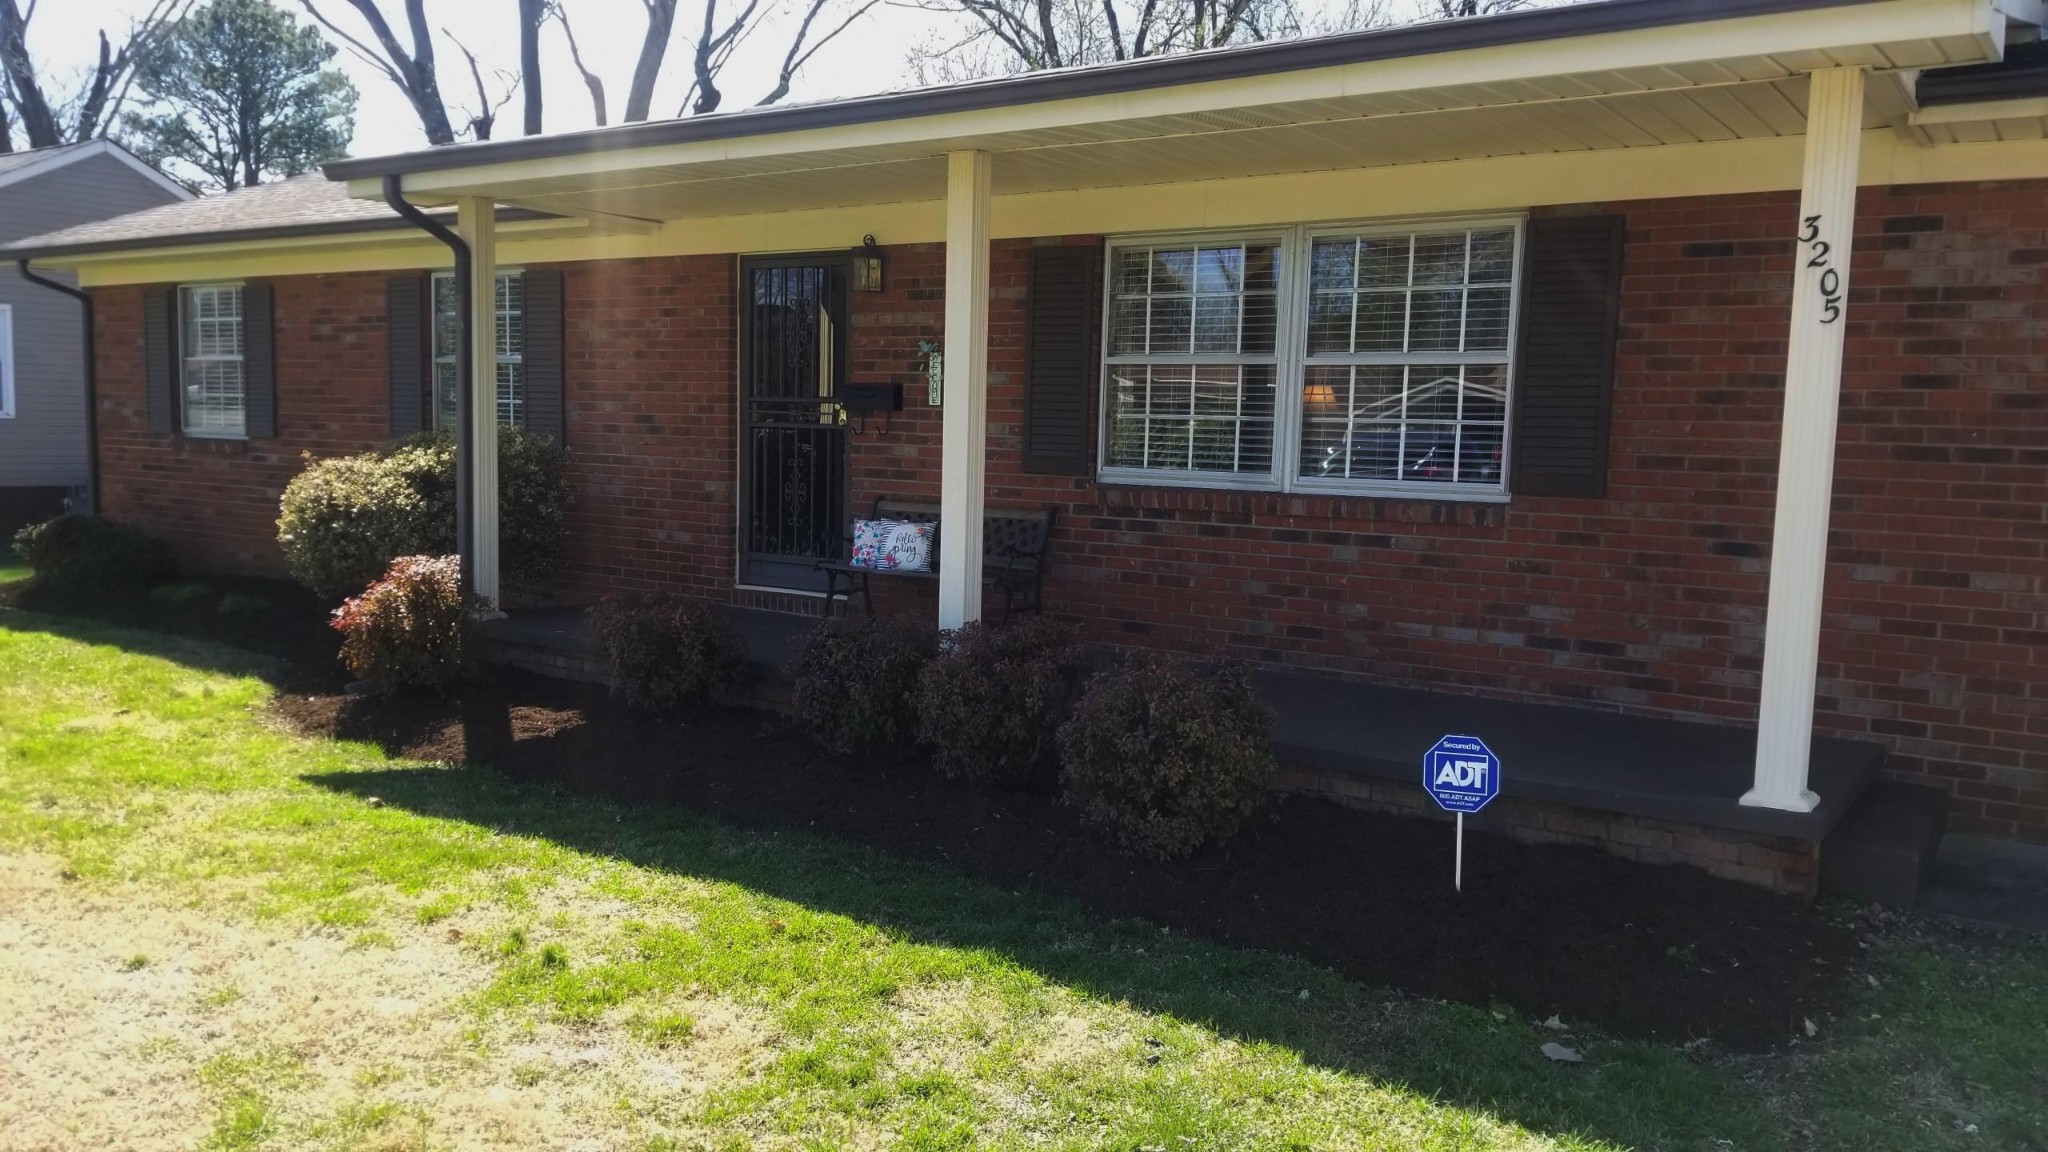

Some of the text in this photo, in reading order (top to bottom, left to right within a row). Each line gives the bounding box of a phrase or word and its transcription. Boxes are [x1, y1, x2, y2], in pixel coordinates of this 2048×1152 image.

[1798, 214, 1842, 324] 3205
[930, 353, 939, 403] WELCOME
[1443, 741, 1480, 751] Secured by
[1435, 760, 1487, 789] ADT
